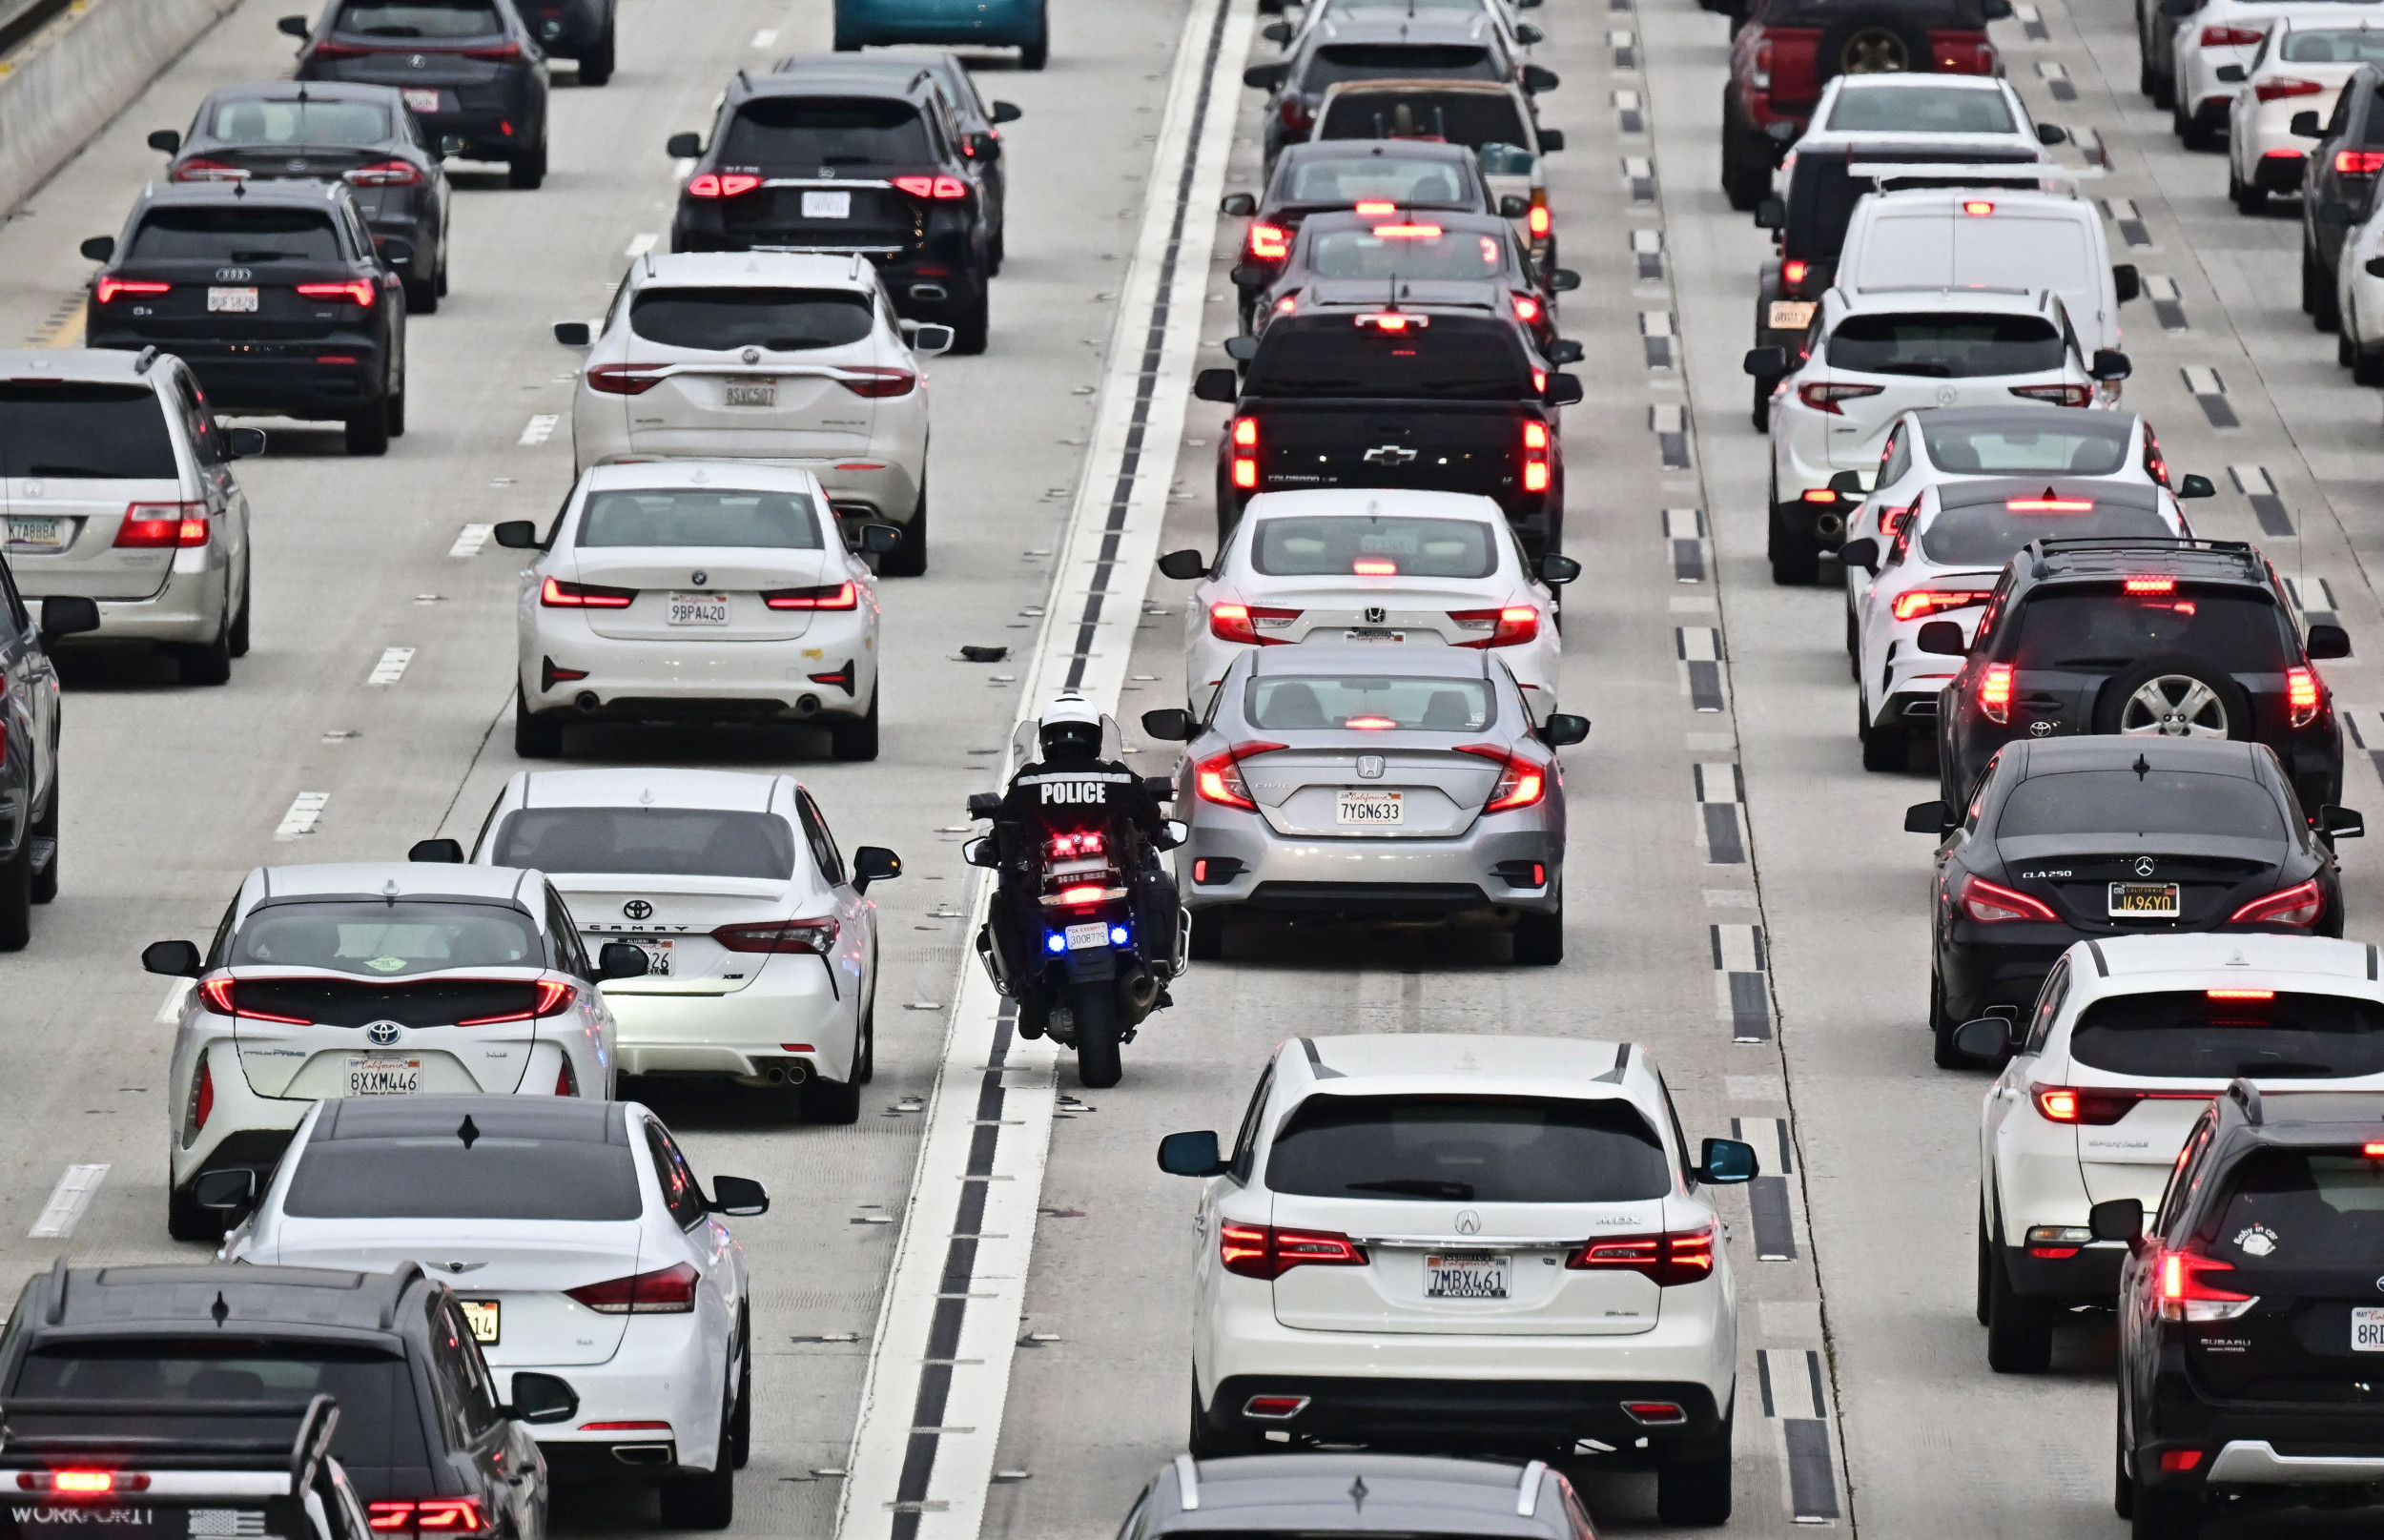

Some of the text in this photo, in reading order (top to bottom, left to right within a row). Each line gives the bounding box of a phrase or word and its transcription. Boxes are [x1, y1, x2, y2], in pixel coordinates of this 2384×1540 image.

[671, 605, 725, 620] 9BPA420
[1040, 781, 1106, 805] POLICE
[1350, 791, 1390, 803] California
[1341, 803, 1399, 819] 7YGN633
[2023, 870, 2072, 879] CLA 250
[1070, 932, 1105, 945] 3008779
[361, 1059, 407, 1072] California
[351, 1072, 417, 1090] 8XXM446
[1595, 1217, 1642, 1225] MDX
[2233, 1227, 2253, 1244] Baby
[2265, 1228, 2278, 1241] car
[1431, 1270, 1502, 1290] 7MBX461
[2200, 1338, 2251, 1346] SUBARU
